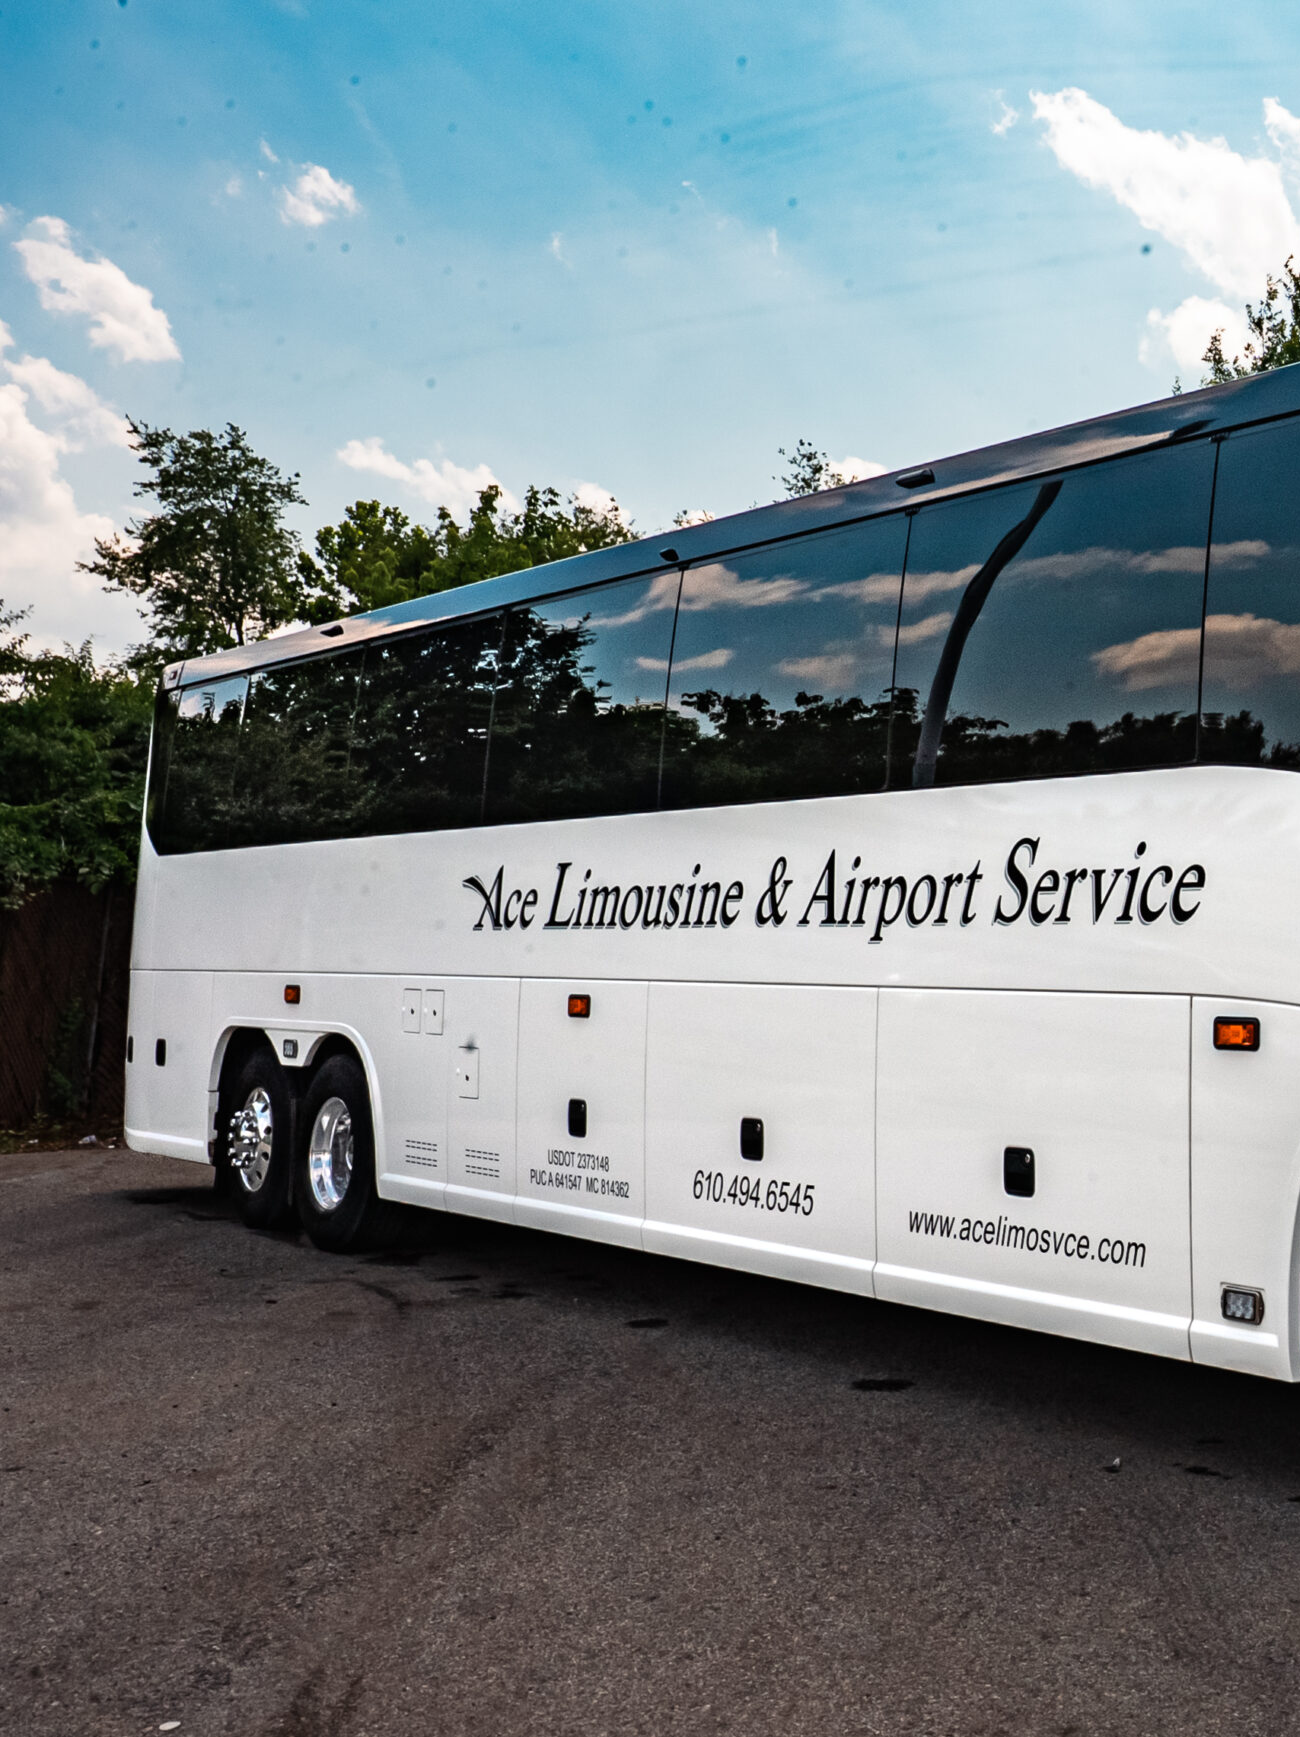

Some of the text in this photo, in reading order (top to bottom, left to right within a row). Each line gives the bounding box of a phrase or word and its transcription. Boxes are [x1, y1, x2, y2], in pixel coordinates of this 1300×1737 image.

[462, 836, 1206, 944] Ace Limousine & Airport Service
[547, 1149, 610, 1173] USDOT 2373148
[586, 1176, 599, 1194] MC
[600, 1178, 630, 1199] 814362
[693, 1170, 815, 1216] 610.494.6545
[909, 1210, 1147, 1268] www.acelimosvce.com
